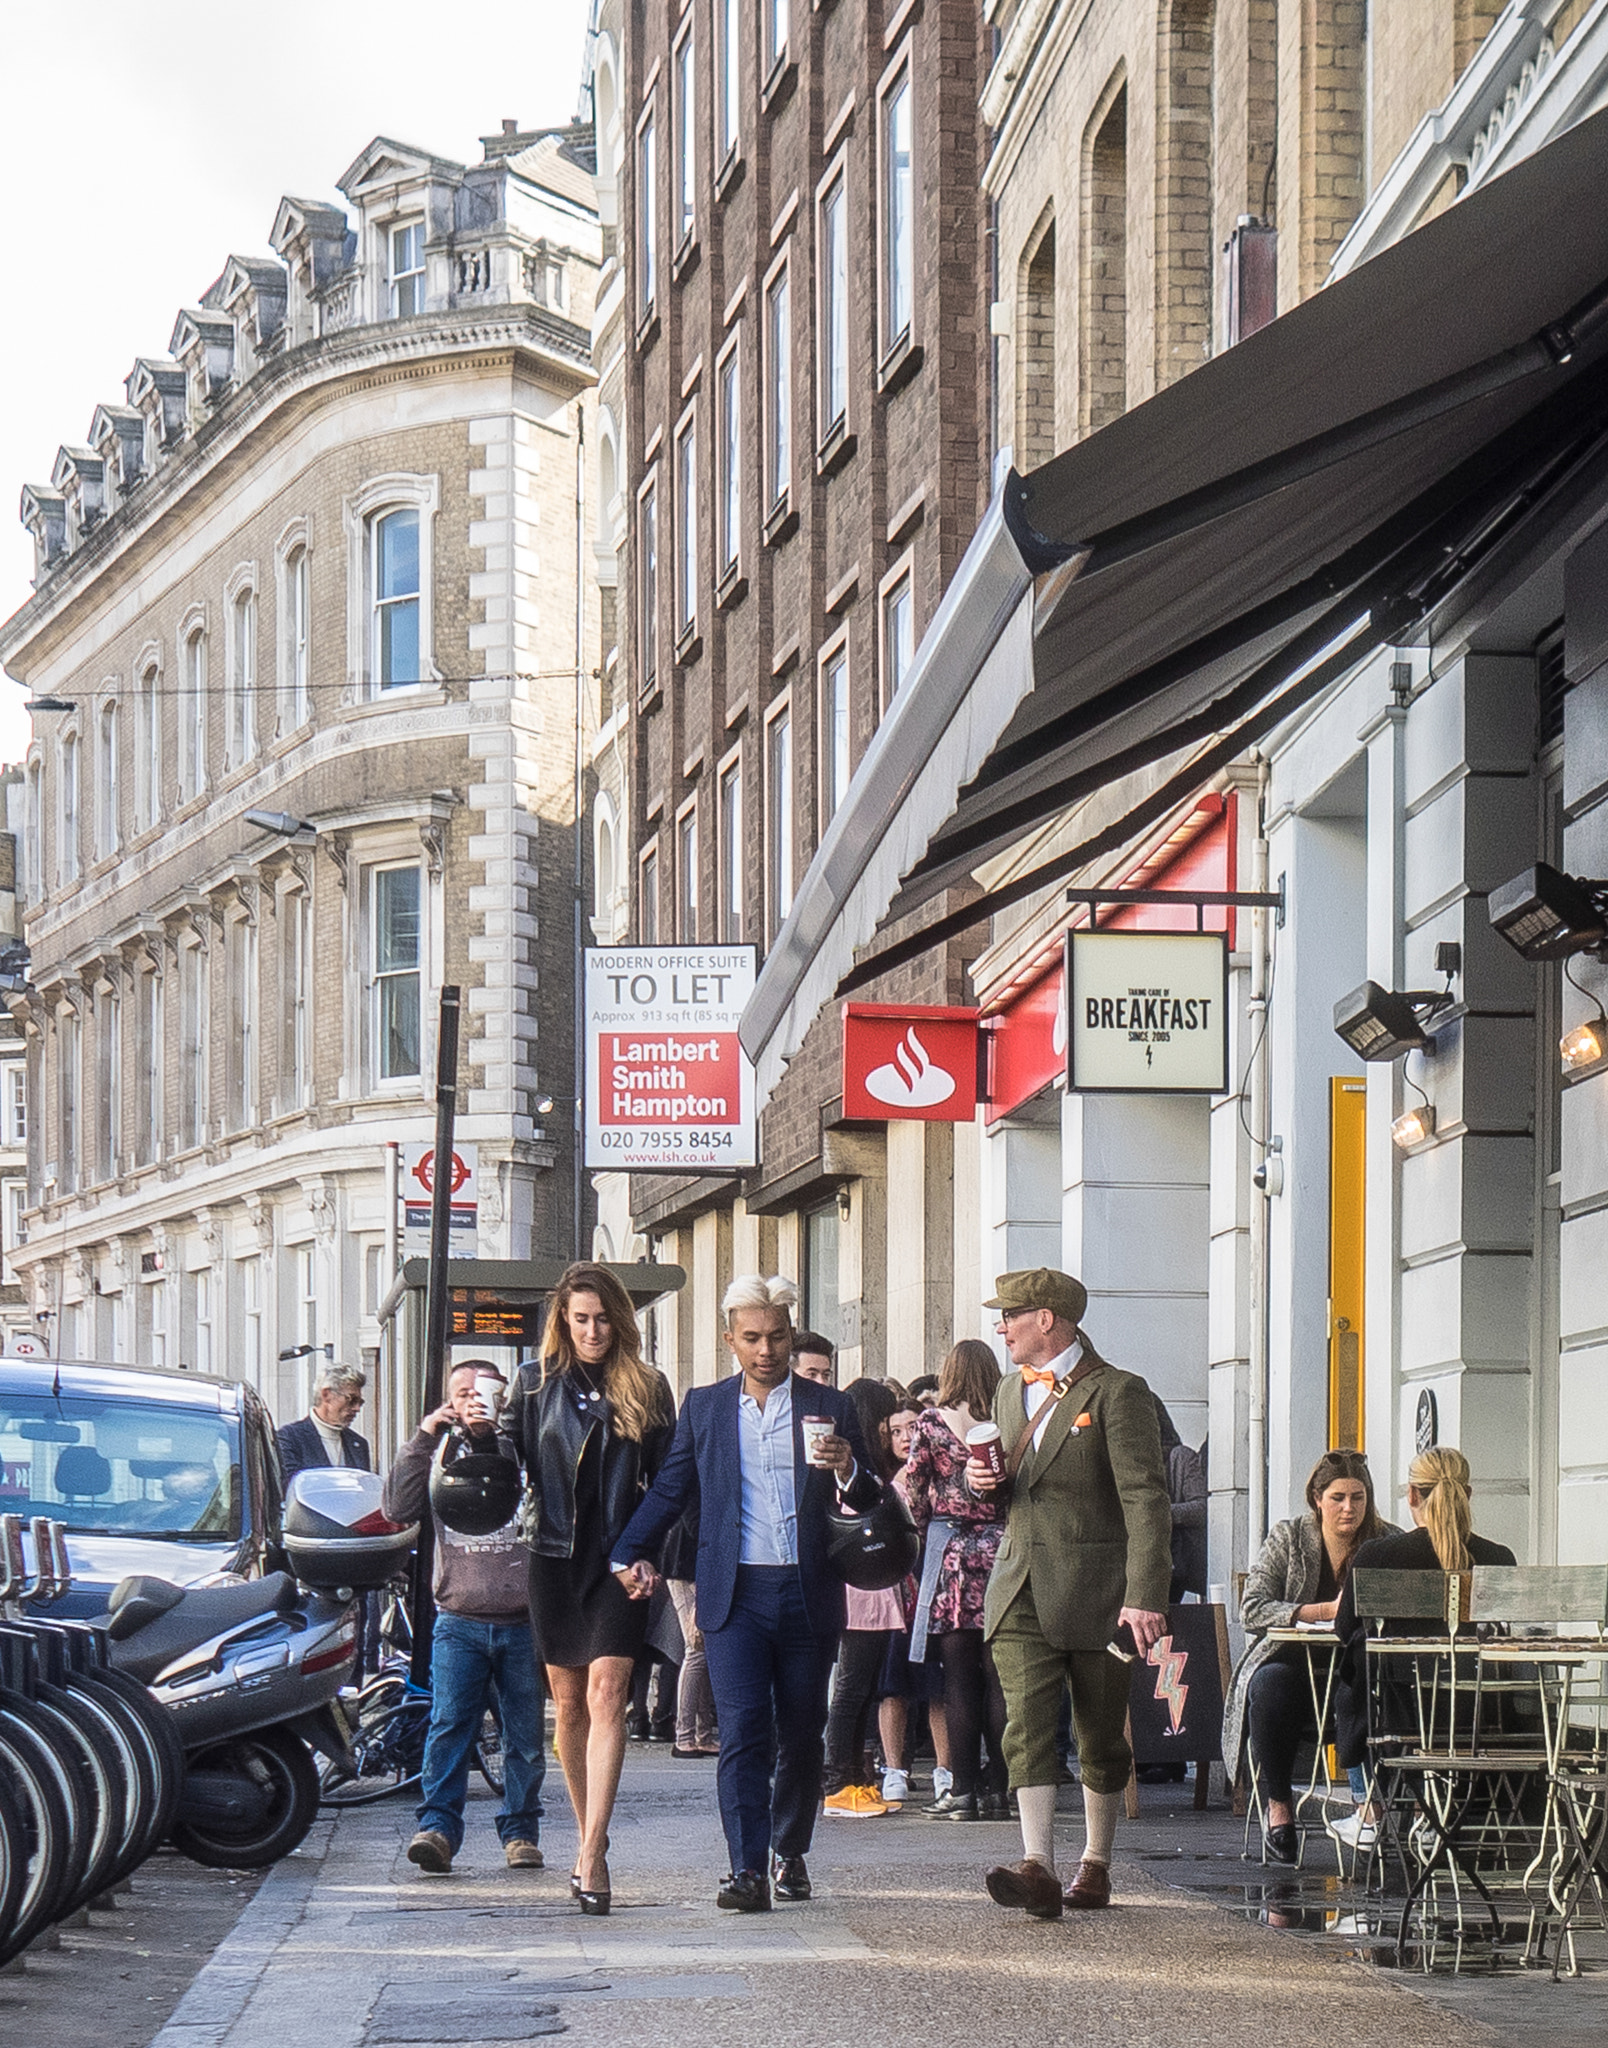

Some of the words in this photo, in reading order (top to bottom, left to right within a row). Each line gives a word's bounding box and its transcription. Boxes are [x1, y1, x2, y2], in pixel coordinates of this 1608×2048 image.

[591, 955, 653, 969] MODERN
[657, 955, 704, 969] OFFICE
[708, 955, 747, 968] SUITE
[607, 974, 657, 1005] TO
[672, 974, 732, 1004] LET
[592, 1010, 635, 1023] Approx
[641, 1010, 662, 1021] 913
[666, 1012, 679, 1023] sq
[682, 1010, 691, 1021] ft
[694, 1009, 712, 1024] (85
[715, 1012, 729, 1023] sq
[1086, 998, 1211, 1030] BREAKFAST
[1128, 1031, 1149, 1042] SINCE
[612, 1037, 720, 1062] Lambert
[612, 1065, 686, 1090] Smith
[612, 1092, 727, 1121] Hampton
[600, 1131, 634, 1148] 020
[640, 1131, 683, 1148] 7955
[689, 1131, 733, 1148] 8454
[623, 1151, 717, 1163] www.lsh.co.uk
